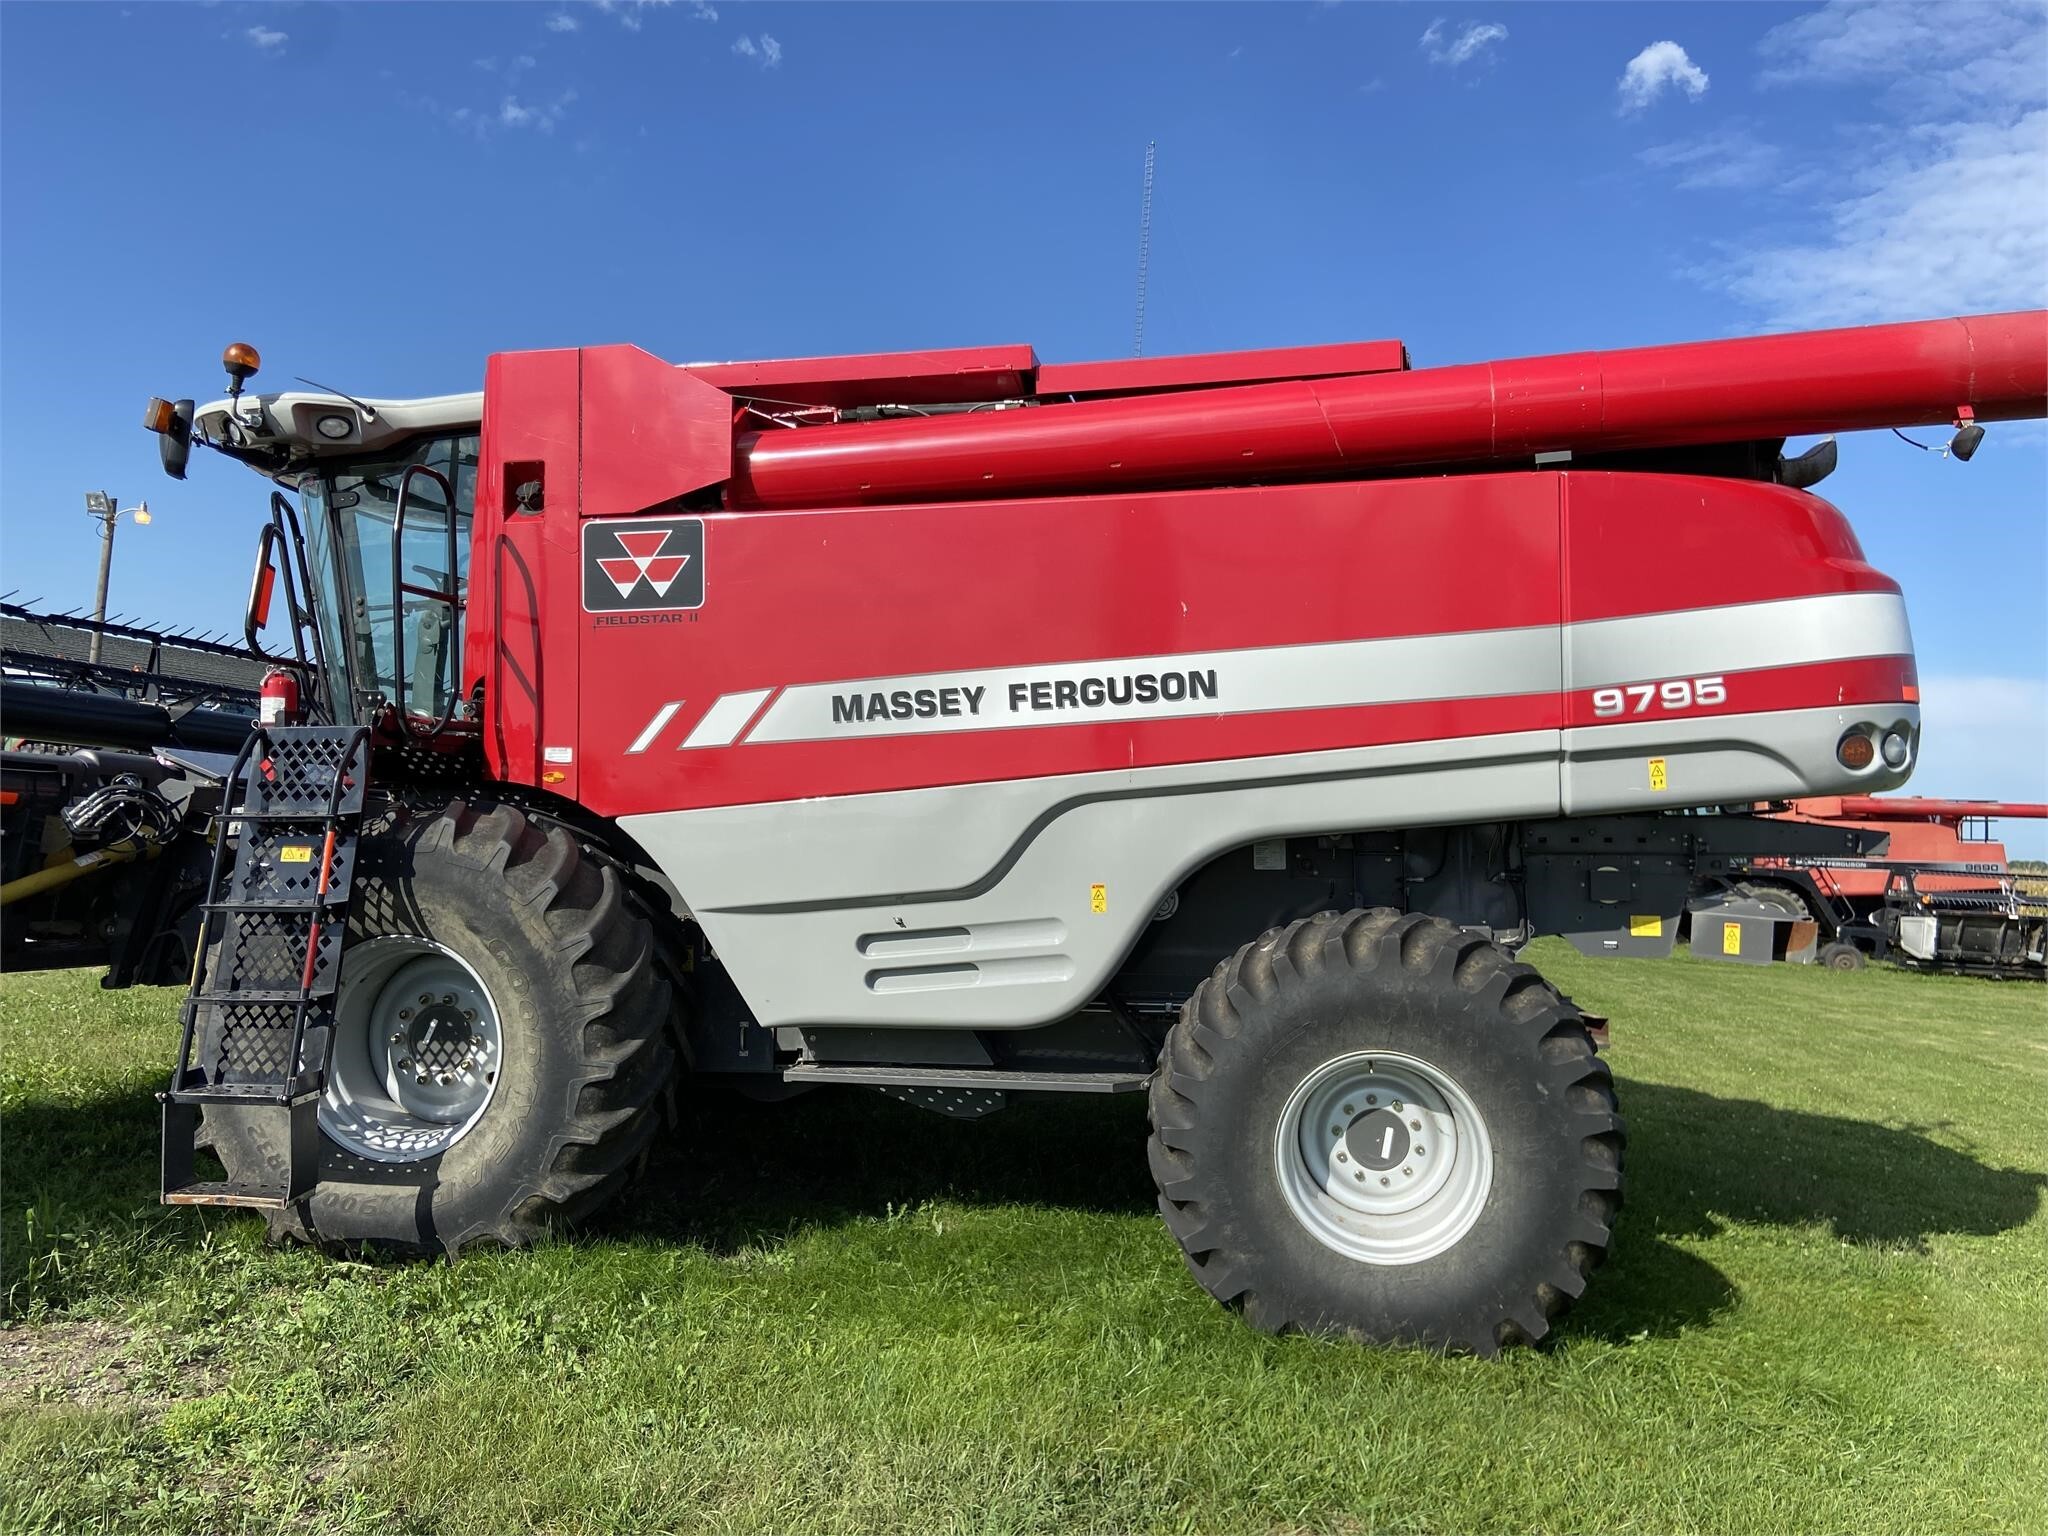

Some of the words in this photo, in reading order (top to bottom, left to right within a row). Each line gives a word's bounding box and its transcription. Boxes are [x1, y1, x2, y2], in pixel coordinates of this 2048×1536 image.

[596, 614, 682, 625] FIELDSTAR
[832, 686, 986, 724] MASSEY
[1008, 669, 1218, 712] FERGUSON
[1592, 676, 1727, 717] 9795
